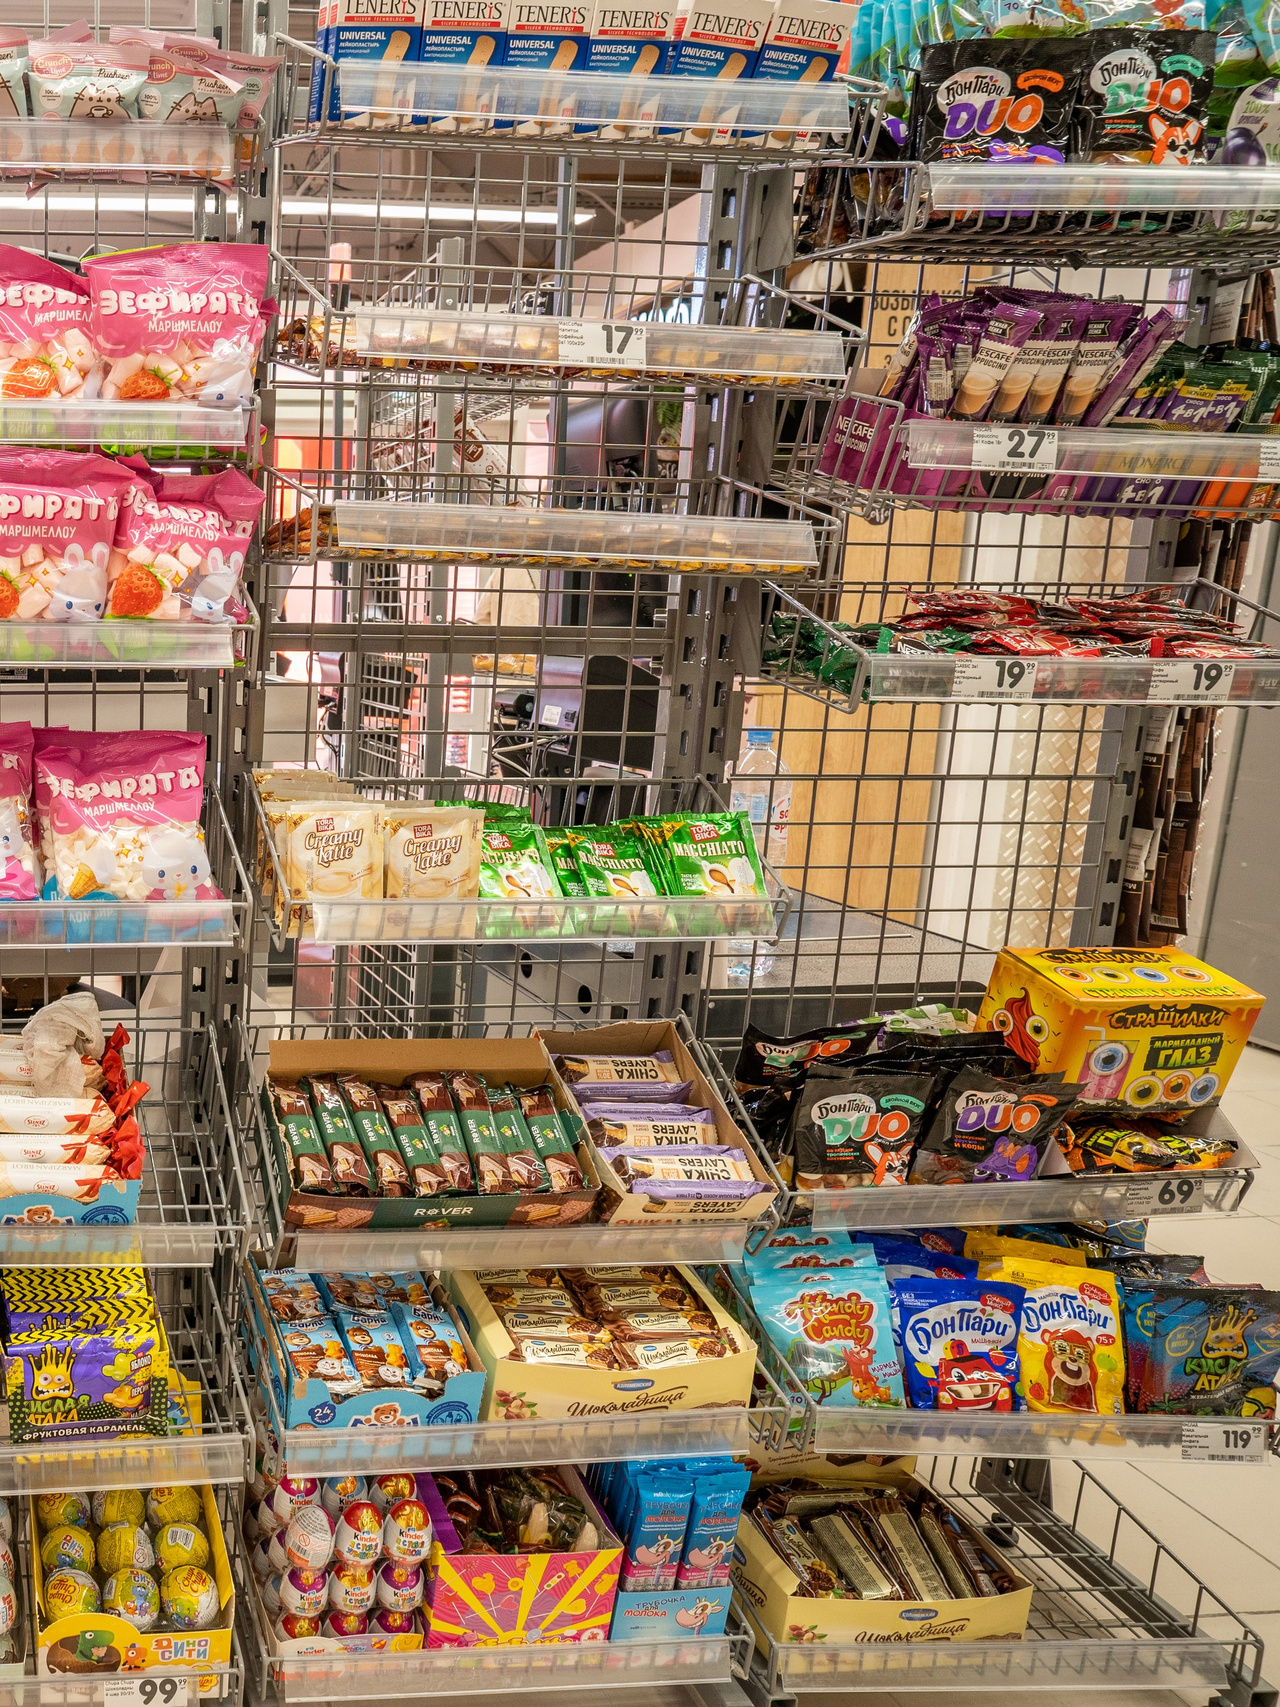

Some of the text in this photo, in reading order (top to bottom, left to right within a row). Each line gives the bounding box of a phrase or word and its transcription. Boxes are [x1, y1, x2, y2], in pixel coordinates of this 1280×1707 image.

[339, 31, 386, 41] UNIVERSAL
[426, 35, 472, 45] UNIVERSAL
[717, 35, 747, 44] TECHNOLOGY
[509, 39, 555, 49] UNIVERSAL
[592, 45, 637, 54] UNIVERSAL
[681, 46, 725, 60] UNIVERSAL
[765, 50, 807, 64] UNIVERSAL
[36, 56, 70, 69] Crunch
[96, 67, 132, 80] Pusheen
[1102, 77, 1192, 116] DUO
[1243, 101, 1269, 114] 100%
[944, 94, 1043, 139] DUO
[100, 290, 259, 318] ЗЕФИРЯТА
[148, 320, 222, 333] МАРШМЕЛЛОУ
[602, 324, 634, 355] 17
[1046, 432, 1056, 440] 99
[1007, 429, 1047, 459] 27
[1026, 663, 1035, 671] 99
[996, 661, 1026, 690] 19
[1193, 663, 1223, 692] 19
[317, 818, 334, 826] TORA
[318, 824, 335, 833] BIKA
[414, 824, 432, 833] TORA
[691, 824, 716, 834] TORA
[305, 829, 364, 851] Creamy
[415, 830, 433, 839] BIKA
[694, 830, 719, 841] BIKA
[404, 835, 463, 858] Creamy
[673, 841, 746, 858] MACCHIATO
[316, 845, 354, 868] Latte
[415, 852, 452, 875] Latte
[578, 850, 645, 870] MACCHIATO
[1109, 1008, 1224, 1030] СТРАШИЛКИ
[1153, 1036, 1221, 1049] МАРМЕЛАДНЫЙ
[611, 1059, 656, 1068] LAYERS
[1157, 1047, 1211, 1068] ГЛАЗ
[615, 1068, 659, 1081] CHIKA
[27, 1099, 72, 1107] MARZIPAN
[956, 1104, 1041, 1133] DUO
[823, 1111, 910, 1145] DUO
[678, 1158, 727, 1168] LAYERS
[1158, 1179, 1195, 1206] 69
[508, 1315, 564, 1330] Шоколадница
[807, 1321, 870, 1348] Candy
[1097, 1335, 1110, 1344] 75
[130, 1355, 152, 1371] ЯБЛОКО
[567, 1385, 689, 1418] Шоколадница
[314, 1406, 331, 1418] 24
[22, 1424, 147, 1441] ФРУКТОВАЯ КАРАМЕЛЬ
[1223, 1429, 1251, 1449] 119
[645, 1514, 687, 1523] МОЛОКА
[635, 1595, 686, 1610] ТРУБОЧКА
[624, 1609, 667, 1617] МОЛОКА
[138, 1679, 178, 1706] 99
